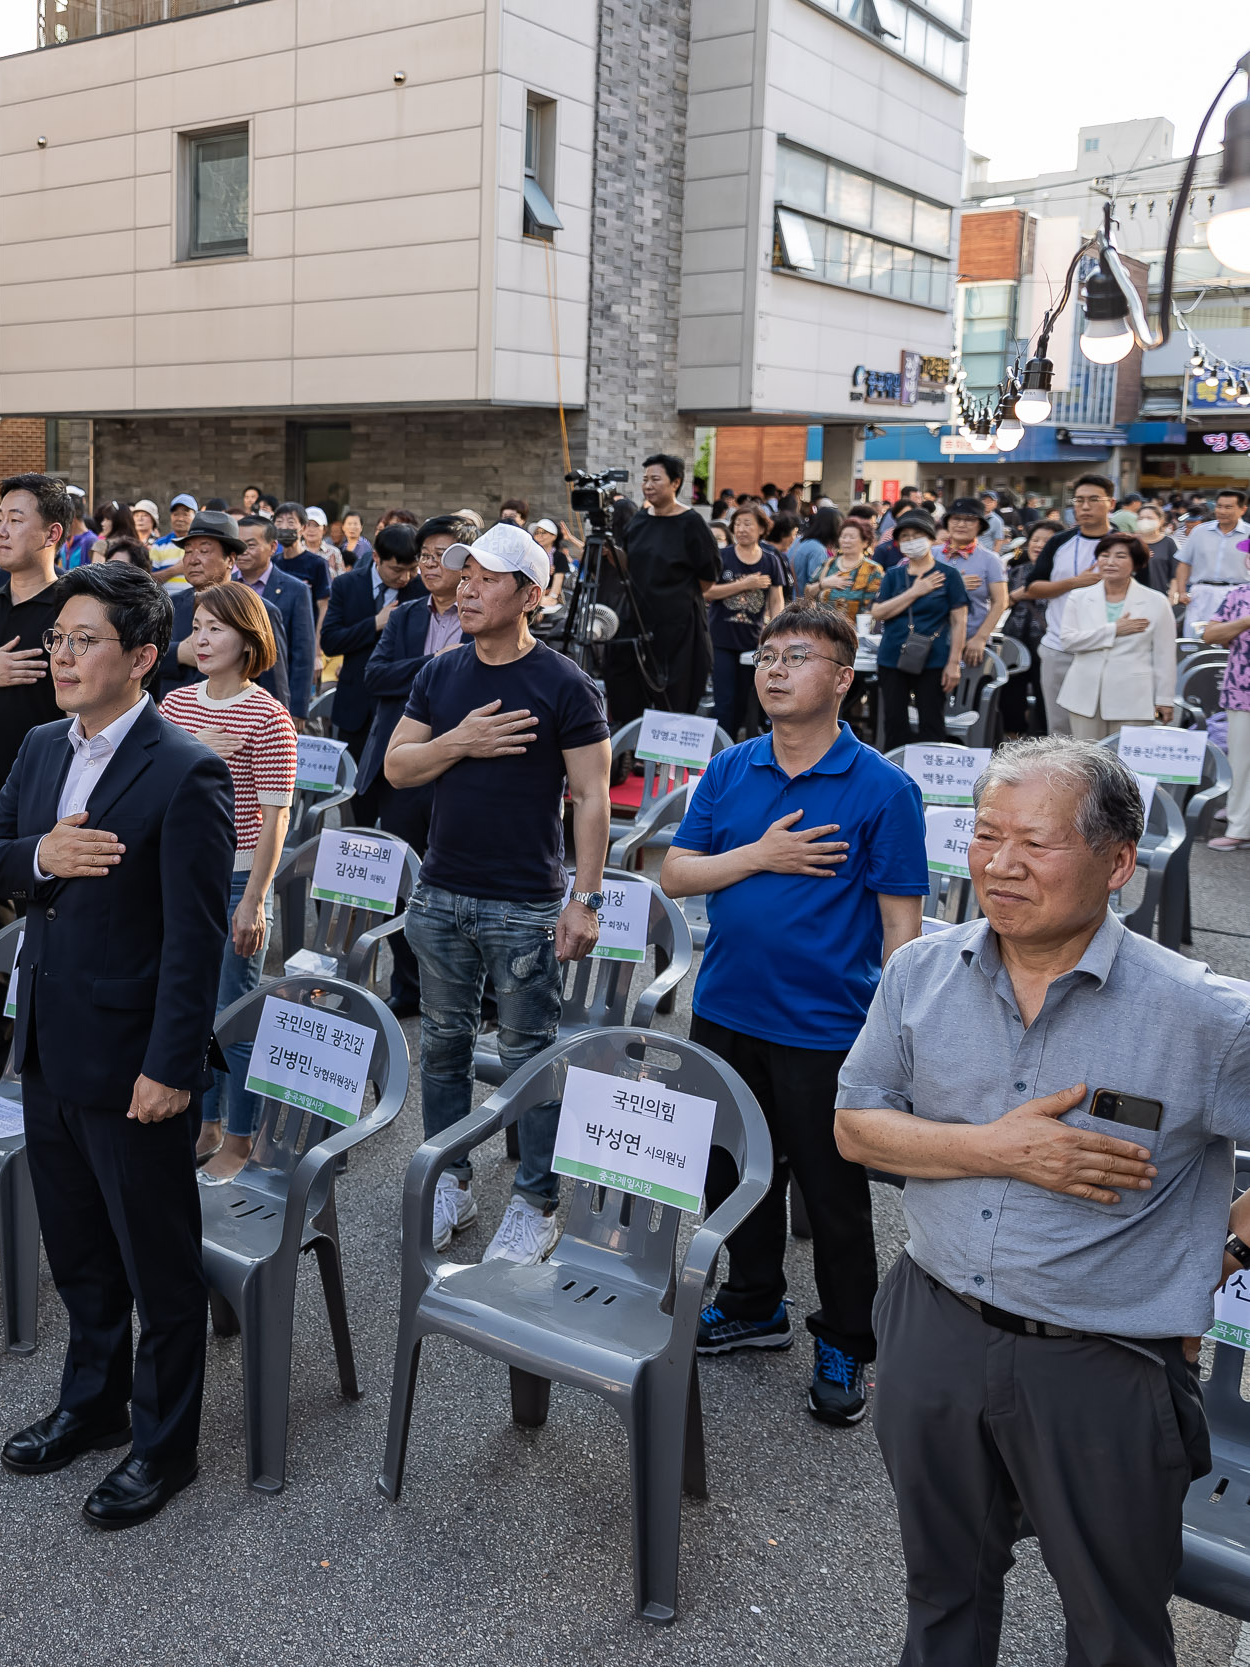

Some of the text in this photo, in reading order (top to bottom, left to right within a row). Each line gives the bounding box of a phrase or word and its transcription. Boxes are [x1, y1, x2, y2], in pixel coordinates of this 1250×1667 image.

[923, 754, 975, 768] 영동교시장
[338, 841, 391, 863] 광진구의회
[336, 862, 368, 880] 김상희
[608, 920, 630, 932] 회장님
[275, 1010, 365, 1056] 국민의힘 광진갑
[269, 1044, 359, 1094] 김병민 당협위원장님
[284, 1090, 325, 1112] 중곡제일시장
[612, 1089, 676, 1124] 국민의힘
[585, 1122, 687, 1169] 박성연 시의원님
[598, 1170, 653, 1195] 중곡제일시장
